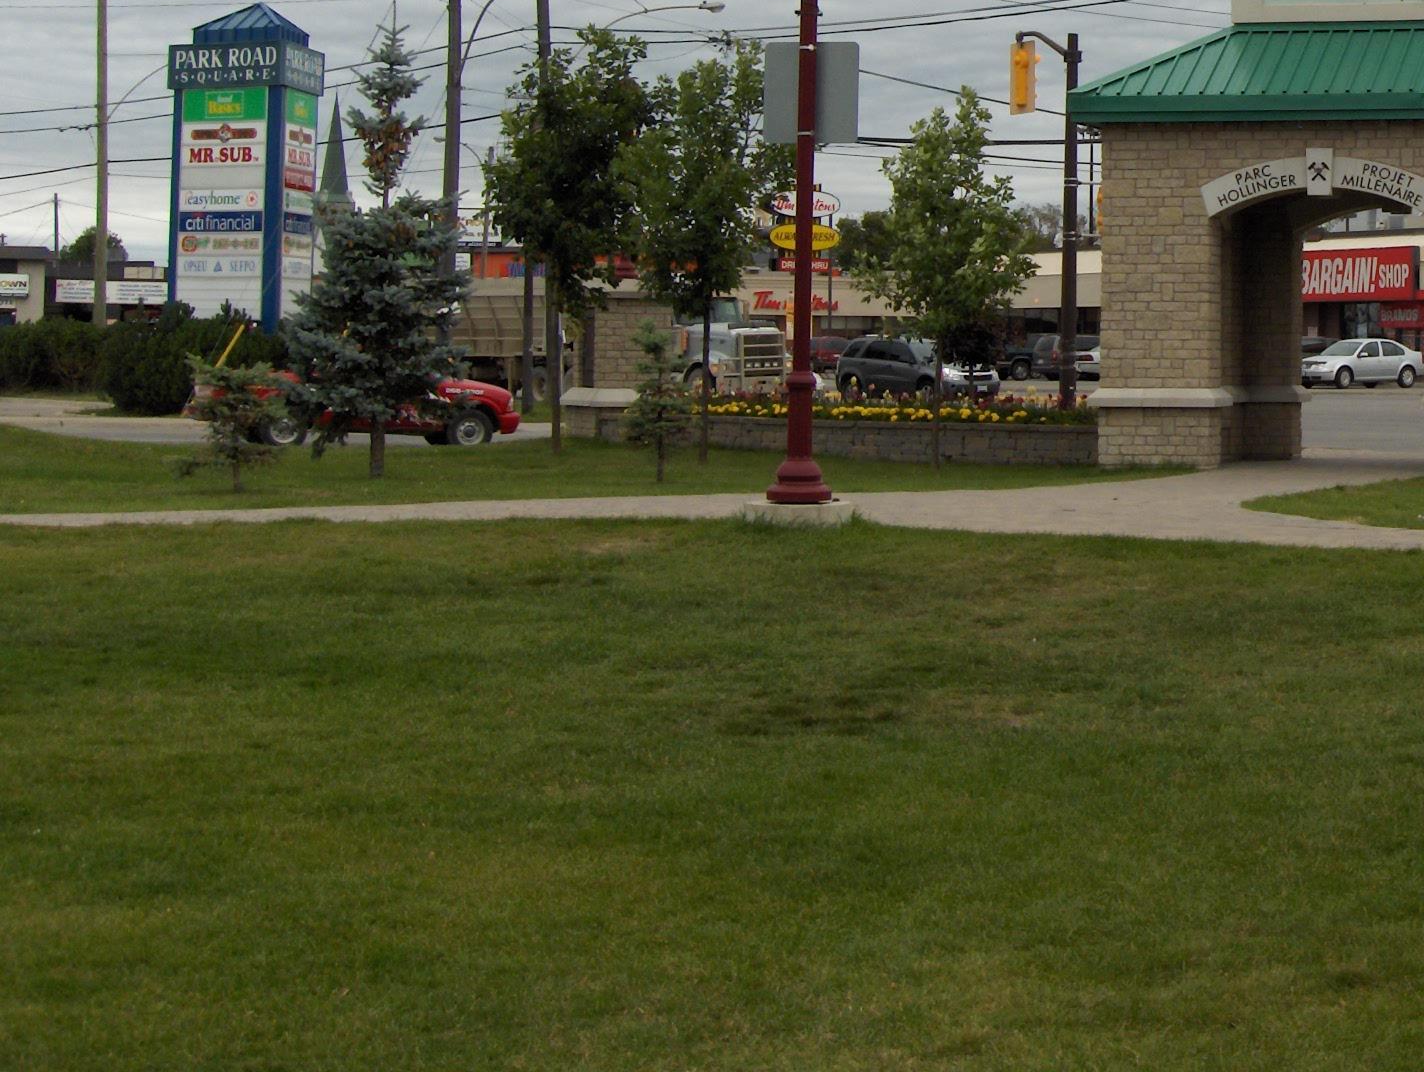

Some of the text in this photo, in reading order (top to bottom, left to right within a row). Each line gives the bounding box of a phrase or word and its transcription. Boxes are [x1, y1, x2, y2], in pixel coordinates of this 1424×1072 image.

[175, 46, 277, 70] PARK ROAD
[219, 147, 252, 163] SUB
[1235, 165, 1272, 185] PARC
[1362, 163, 1414, 187] PROJET
[1217, 174, 1296, 207] HOLLINGER
[1341, 175, 1423, 207] MILLENAIRE
[774, 232, 836, 242] ALWA RESH
[782, 261, 829, 270] DRI HRU
[1379, 264, 1410, 288] SHOP
[753, 291, 781, 310] Tim
